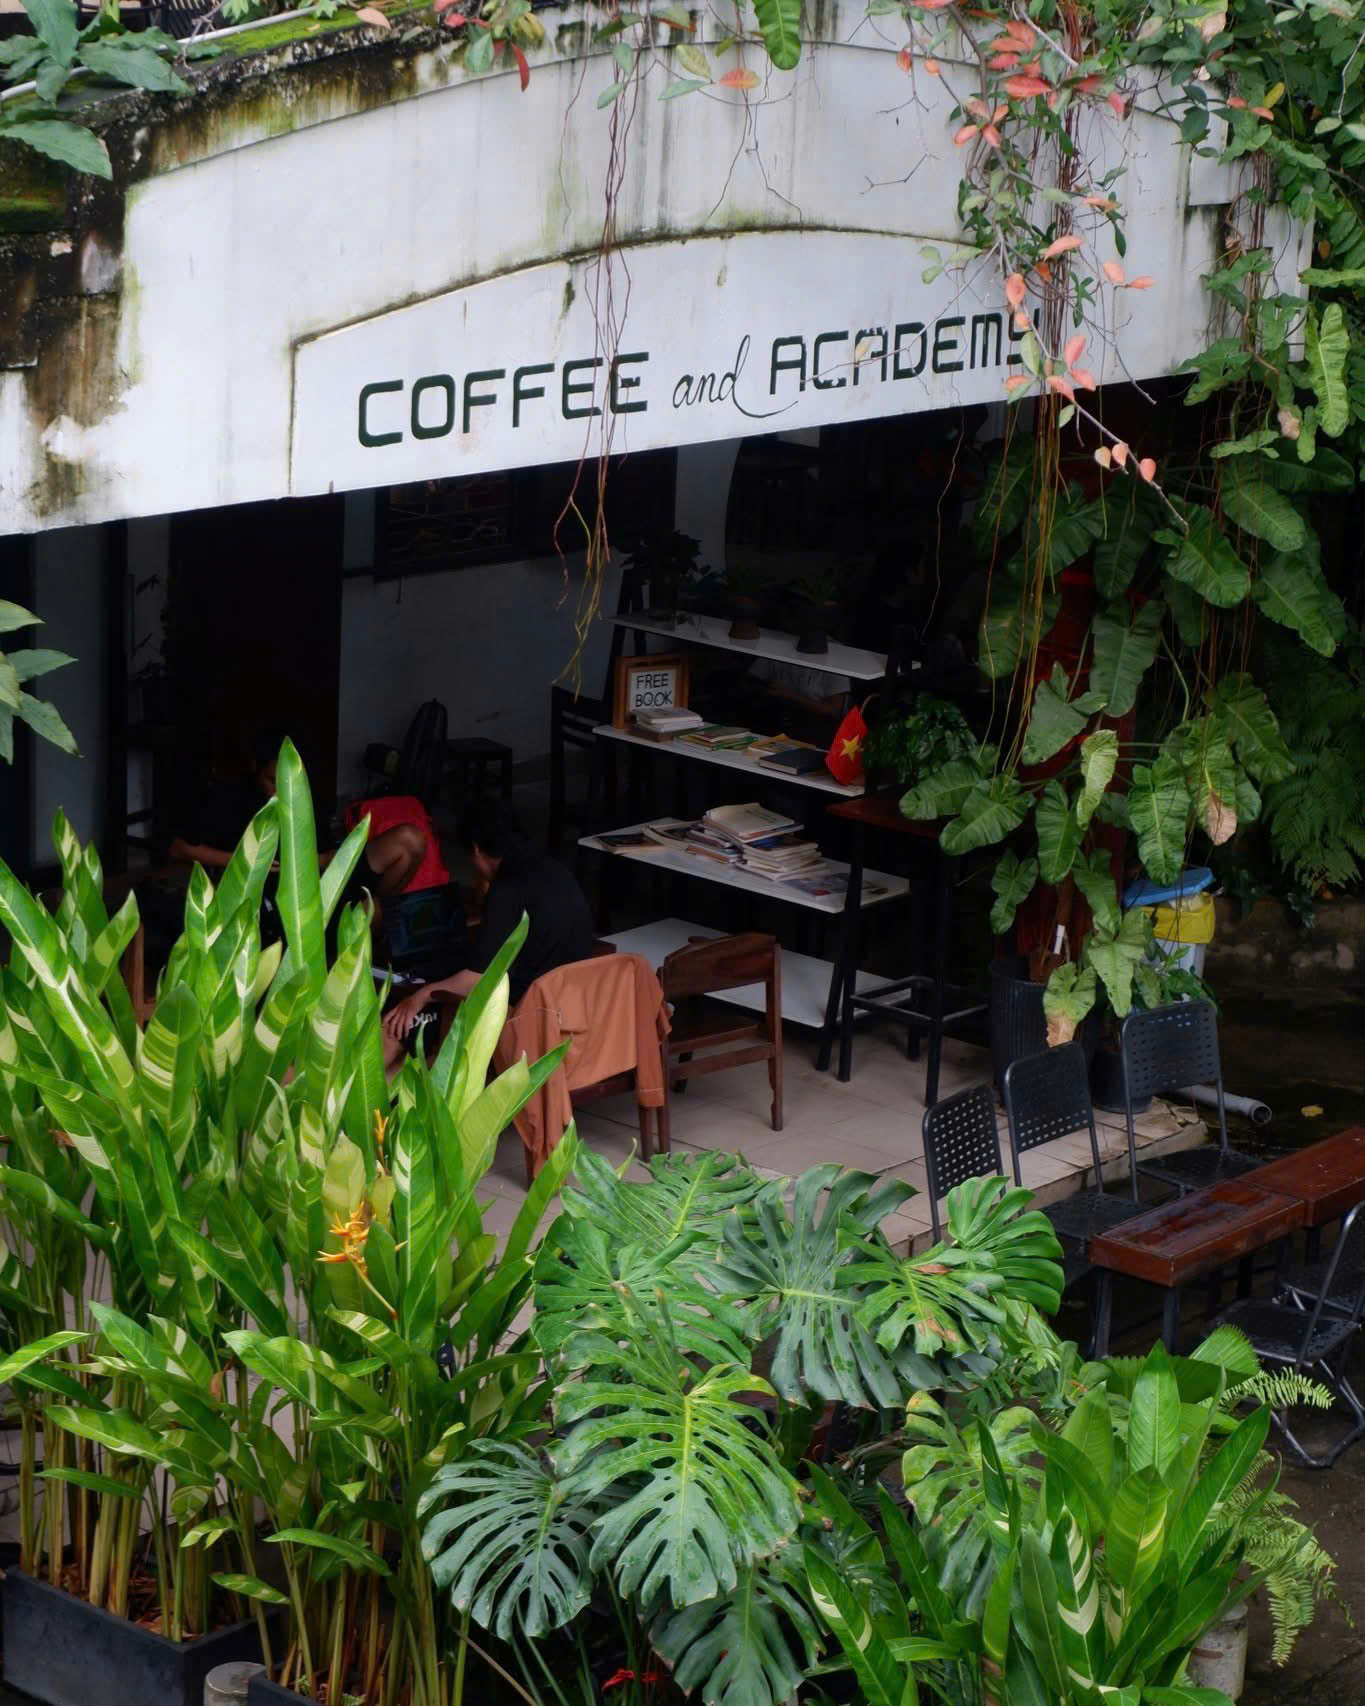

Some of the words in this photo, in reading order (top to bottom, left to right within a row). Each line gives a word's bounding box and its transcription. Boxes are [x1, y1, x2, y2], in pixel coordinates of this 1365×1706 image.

[358, 351, 649, 447] COFFEE
[672, 334, 799, 418] and
[636, 673, 669, 689] FREE
[635, 691, 673, 708] BOOK
